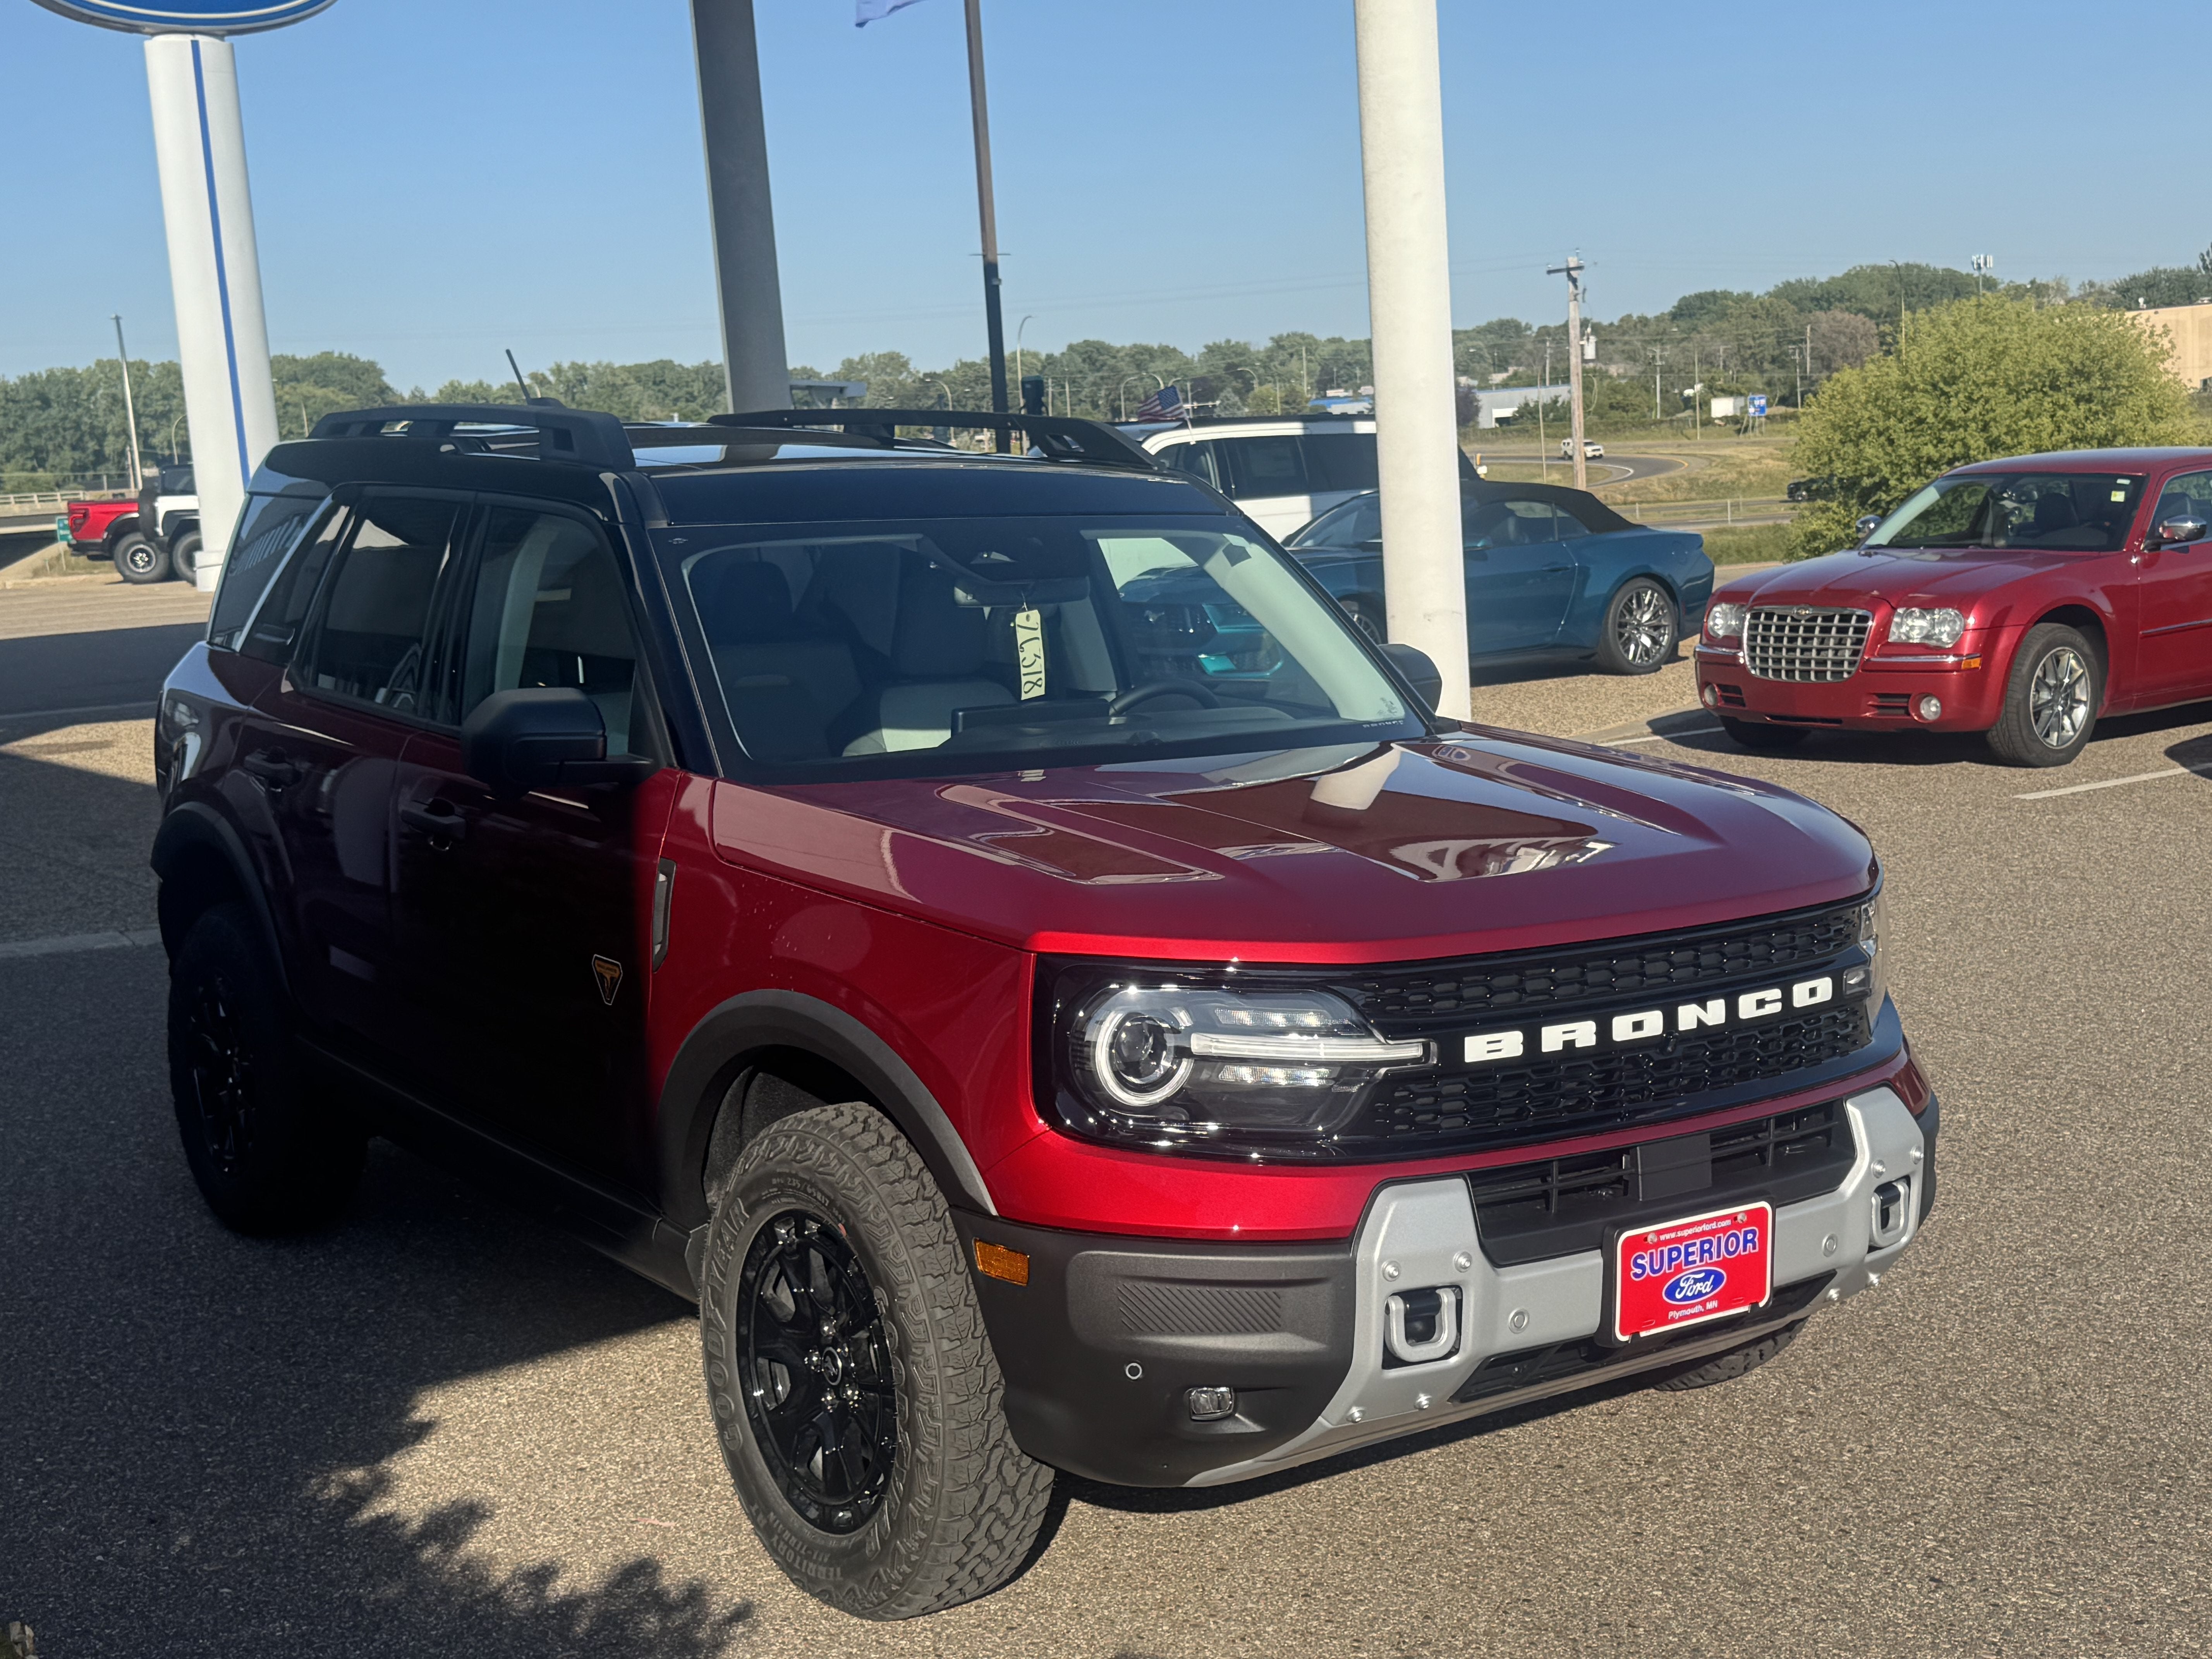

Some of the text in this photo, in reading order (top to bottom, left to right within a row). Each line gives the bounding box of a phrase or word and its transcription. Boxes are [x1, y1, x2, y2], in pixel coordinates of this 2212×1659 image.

[1464, 977, 1832, 1063] BRONCO
[1660, 1219, 1731, 1240] www.superiorford.com
[1630, 1227, 1759, 1281] SUPERIOR
[1675, 1273, 1715, 1299] Ford
[1706, 1300, 1718, 1310] MN
[706, 1197, 750, 1451] GOODYEAR
[771, 1534, 843, 1581] TERRITORY
